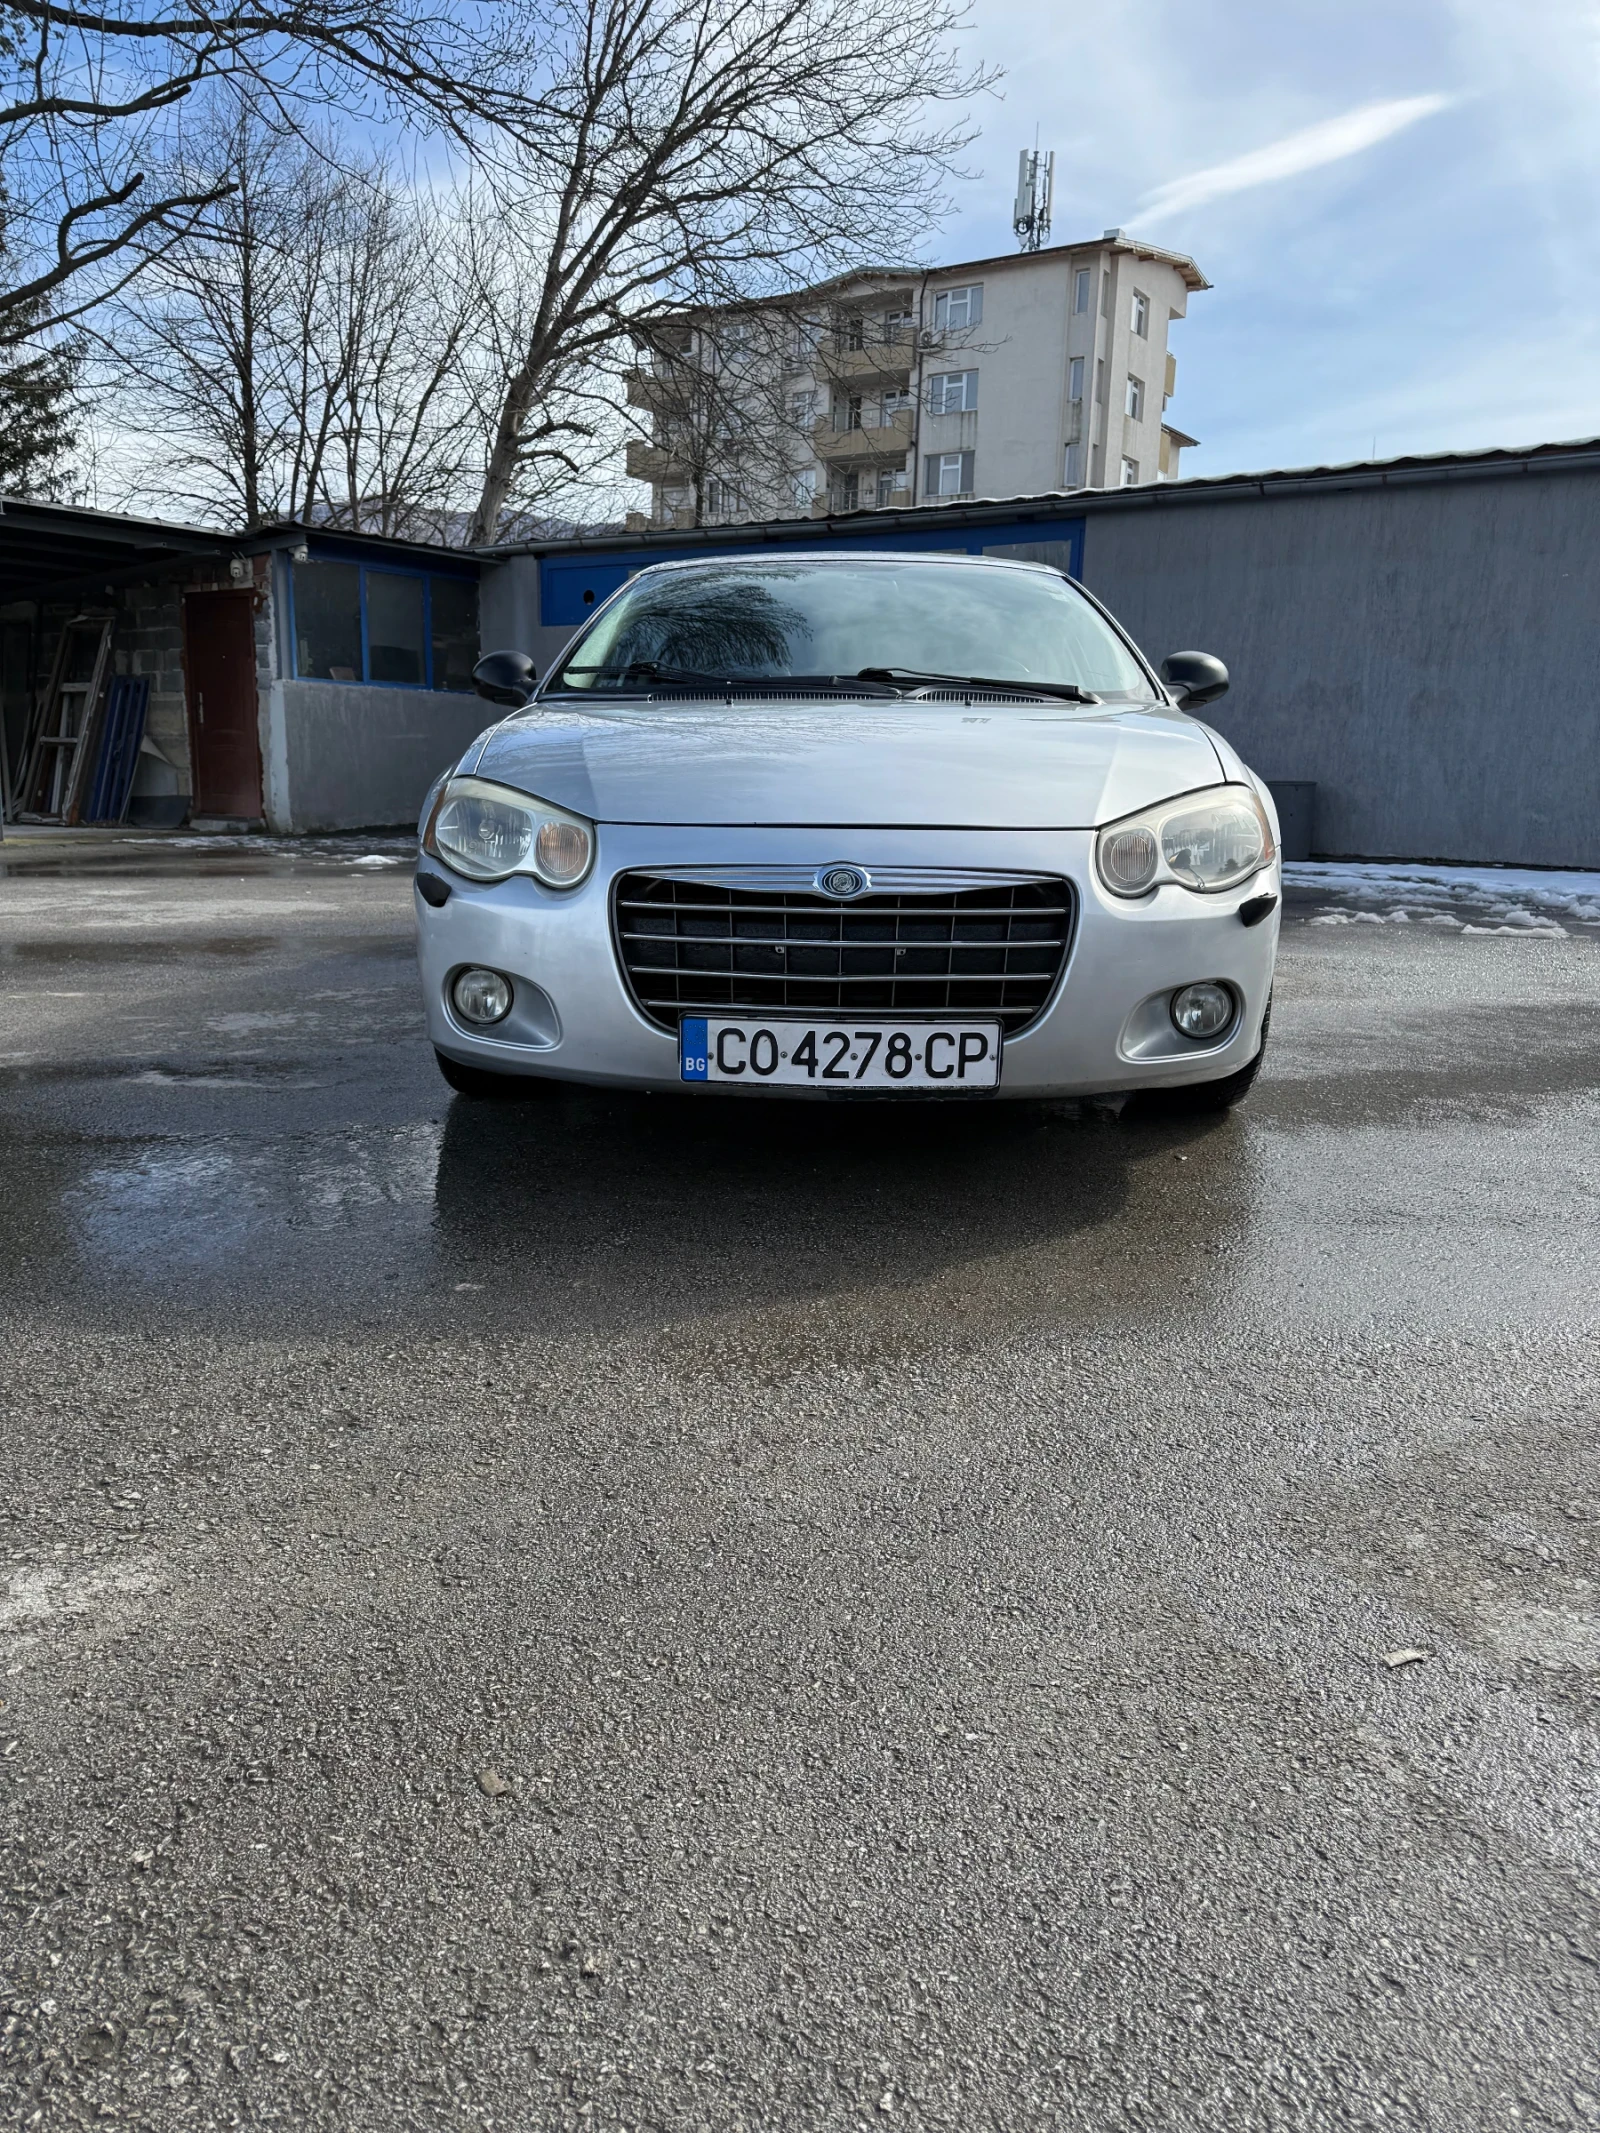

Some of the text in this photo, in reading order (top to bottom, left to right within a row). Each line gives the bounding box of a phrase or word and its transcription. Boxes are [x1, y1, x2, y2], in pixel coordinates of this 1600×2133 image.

[685, 1057, 706, 1072] BG
[717, 1027, 989, 1079] CO 4278 CP
